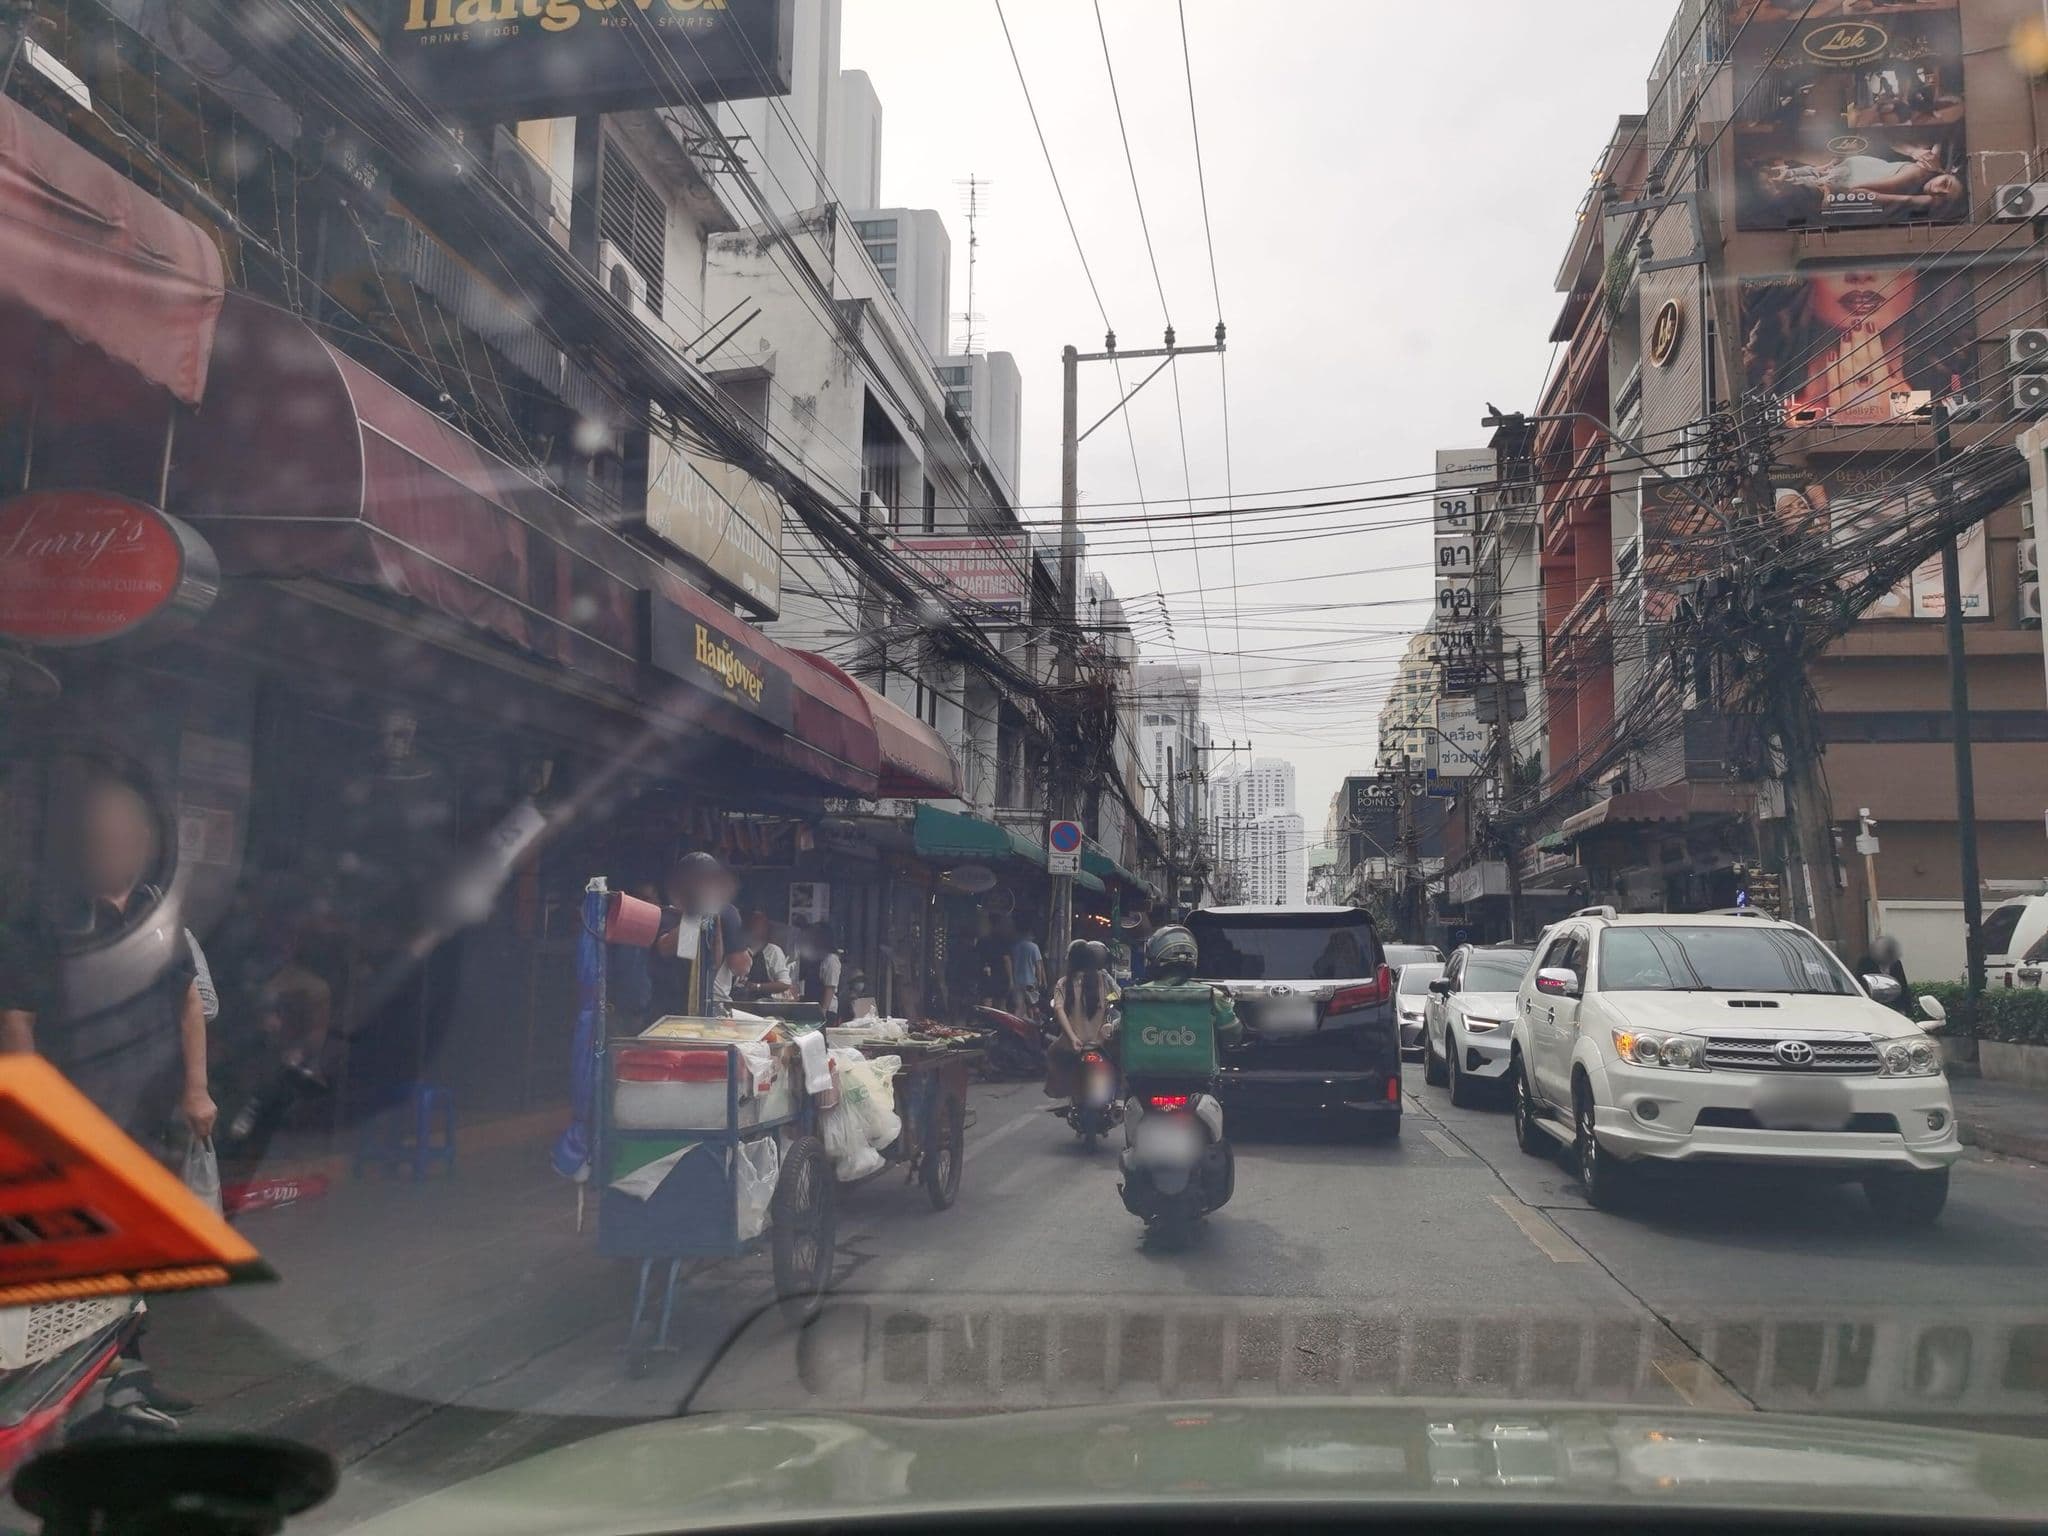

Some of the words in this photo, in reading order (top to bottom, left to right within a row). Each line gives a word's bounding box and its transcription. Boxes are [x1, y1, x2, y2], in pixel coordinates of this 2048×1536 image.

[1820, 29, 1866, 51] Lek
[1440, 545, 1470, 566] ตา
[954, 576, 1024, 595] APARTMENT
[1440, 588, 1471, 608] คอ
[695, 623, 764, 703] Hangover
[1358, 797, 1395, 807] POINTS
[1142, 1025, 1197, 1047] Grab
